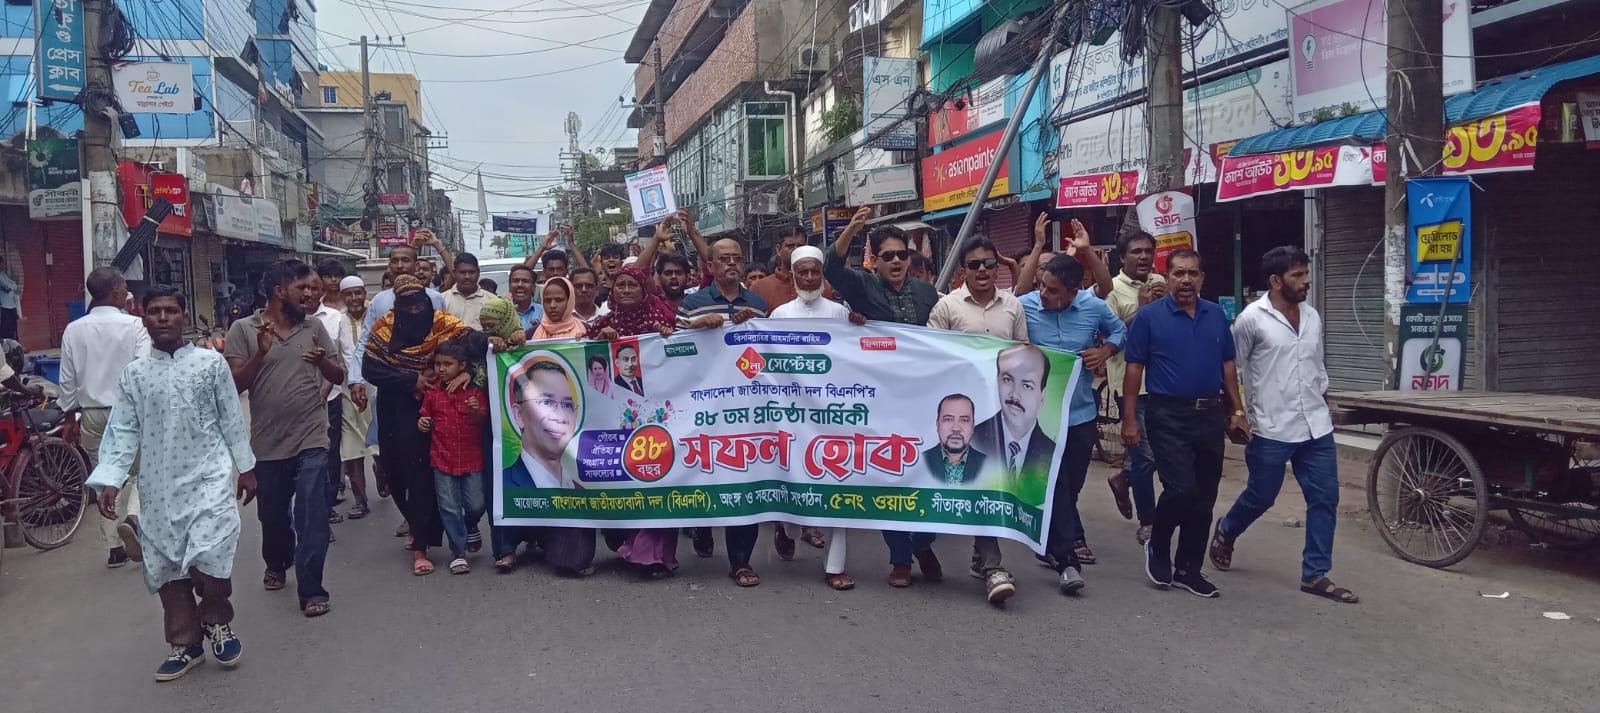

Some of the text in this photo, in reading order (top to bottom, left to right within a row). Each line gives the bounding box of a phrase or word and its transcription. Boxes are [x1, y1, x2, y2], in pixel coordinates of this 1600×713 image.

[47, 48, 82, 63] প্রেস
[48, 65, 82, 81] ক্লাব
[128, 80, 179, 95] Tea Lab
[948, 147, 995, 183] asianpaints
[1153, 213, 1180, 227] নগদ
[666, 345, 696, 354] বাংলাদেশ
[768, 356, 826, 372] সেপ্টেম্বর
[690, 386, 735, 401] বাংলাদেশ
[737, 380, 801, 397] জাতীয়তাবাদী
[804, 386, 822, 397] দল
[694, 400, 870, 426] ৪৮ তম প্রতিষ্ঠা বার্ষিকী
[630, 435, 667, 461] ৪৮
[679, 430, 923, 482] সফল হোক
[635, 463, 662, 477] বছর
[551, 496, 588, 510] বাংলাদেশ
[589, 492, 645, 510] জাতীয়তাবাদী
[647, 495, 663, 510] দল
[745, 493, 754, 504] ও
[755, 484, 789, 505] সহযোগী
[931, 492, 972, 519] সীতাকুণ্ড
